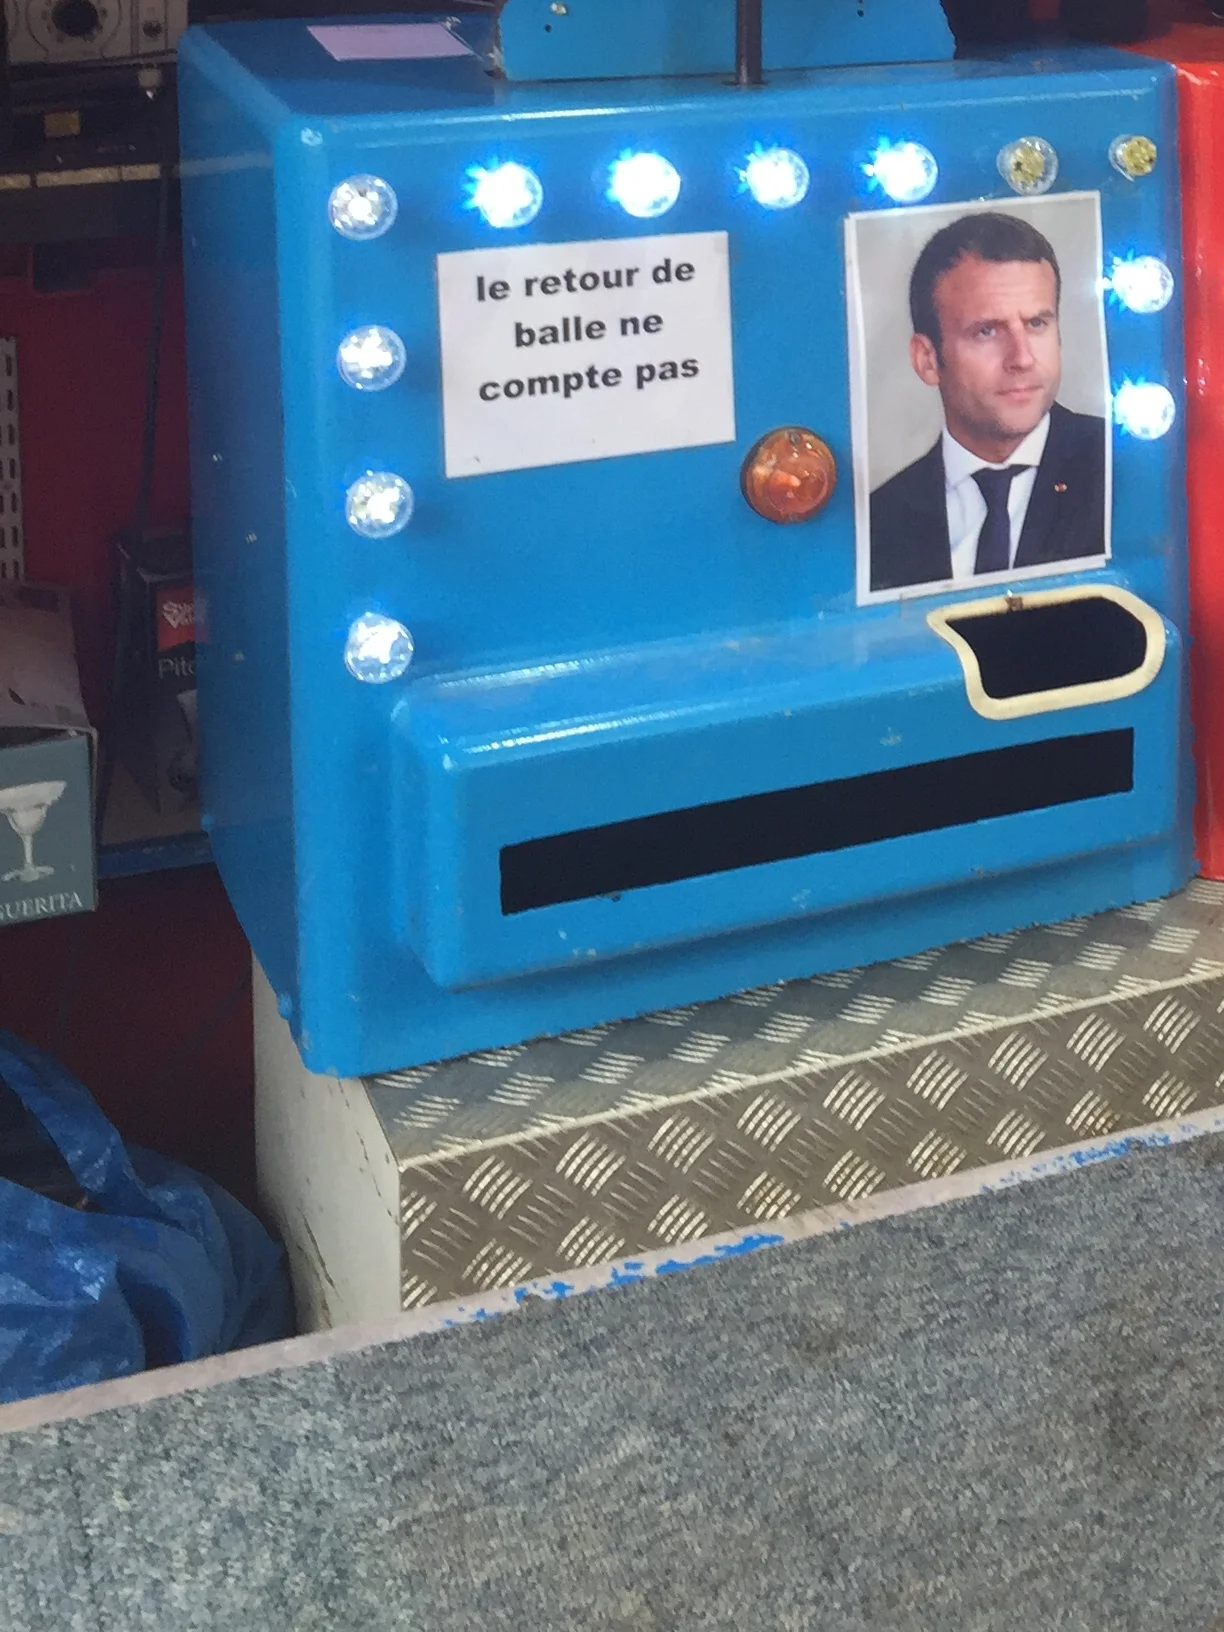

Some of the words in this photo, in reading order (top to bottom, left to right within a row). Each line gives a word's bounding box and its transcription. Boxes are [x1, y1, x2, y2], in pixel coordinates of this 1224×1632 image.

[477, 276, 510, 302] le
[524, 267, 639, 296] retour
[651, 257, 695, 285] de
[515, 315, 606, 348] balle
[619, 313, 663, 336] ne
[479, 364, 622, 402] compte
[635, 357, 700, 390] pas
